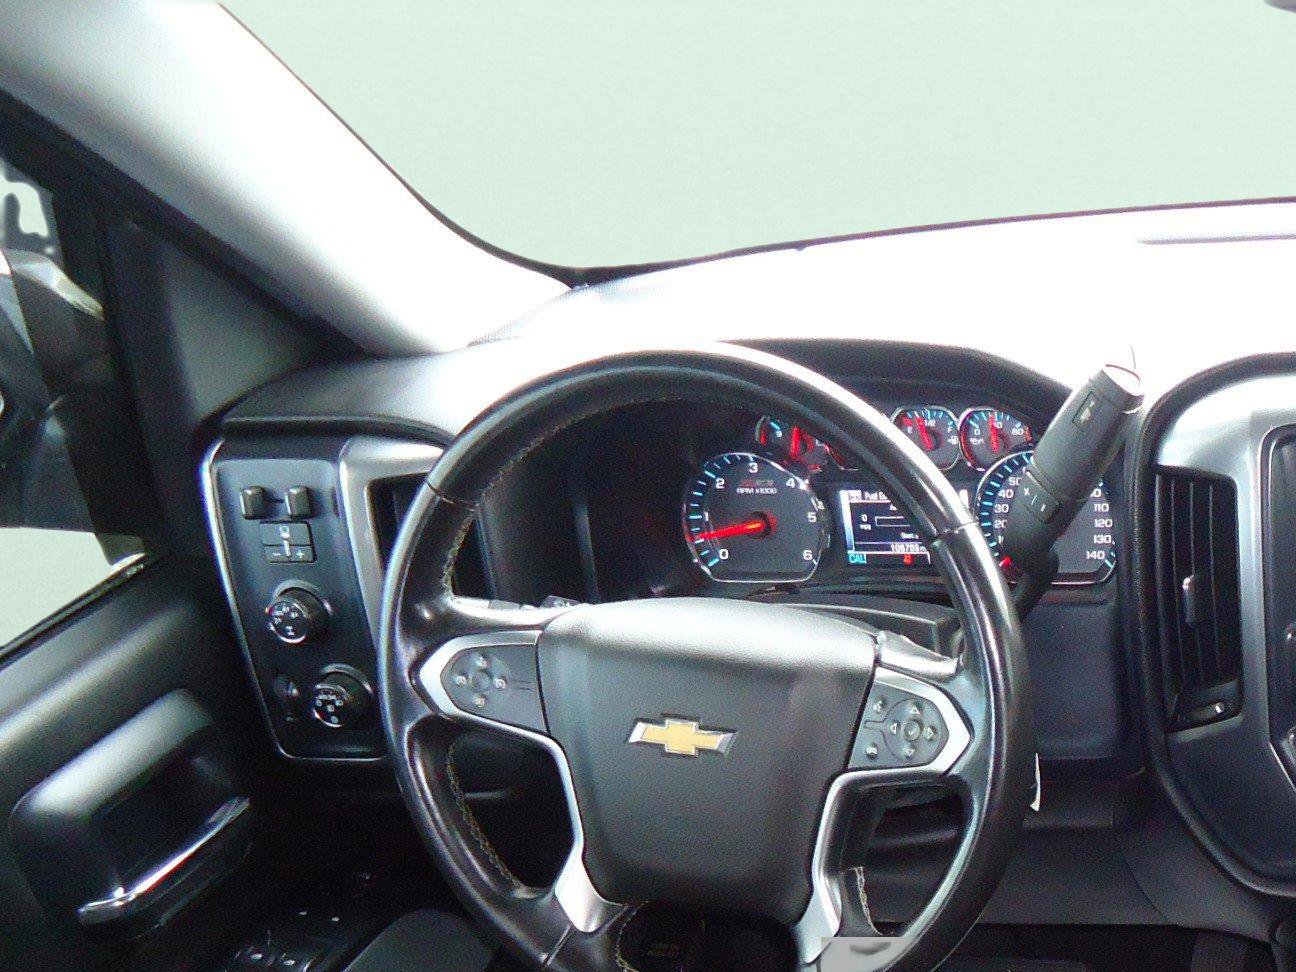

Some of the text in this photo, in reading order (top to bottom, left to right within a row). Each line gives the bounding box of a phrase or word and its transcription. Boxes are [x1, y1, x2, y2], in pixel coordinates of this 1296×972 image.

[749, 462, 759, 473] 3
[715, 477, 725, 489] 2
[786, 477, 796, 488] 4
[998, 489, 1014, 498] 40
[995, 504, 1009, 513] 30
[1093, 503, 1110, 512] 110
[703, 511, 710, 522] 1
[807, 512, 817, 523] 5
[1094, 518, 1113, 528] 120
[1093, 534, 1112, 544] 130
[719, 548, 729, 560] 0
[802, 550, 813, 561] 6
[1086, 550, 1106, 559] 140
